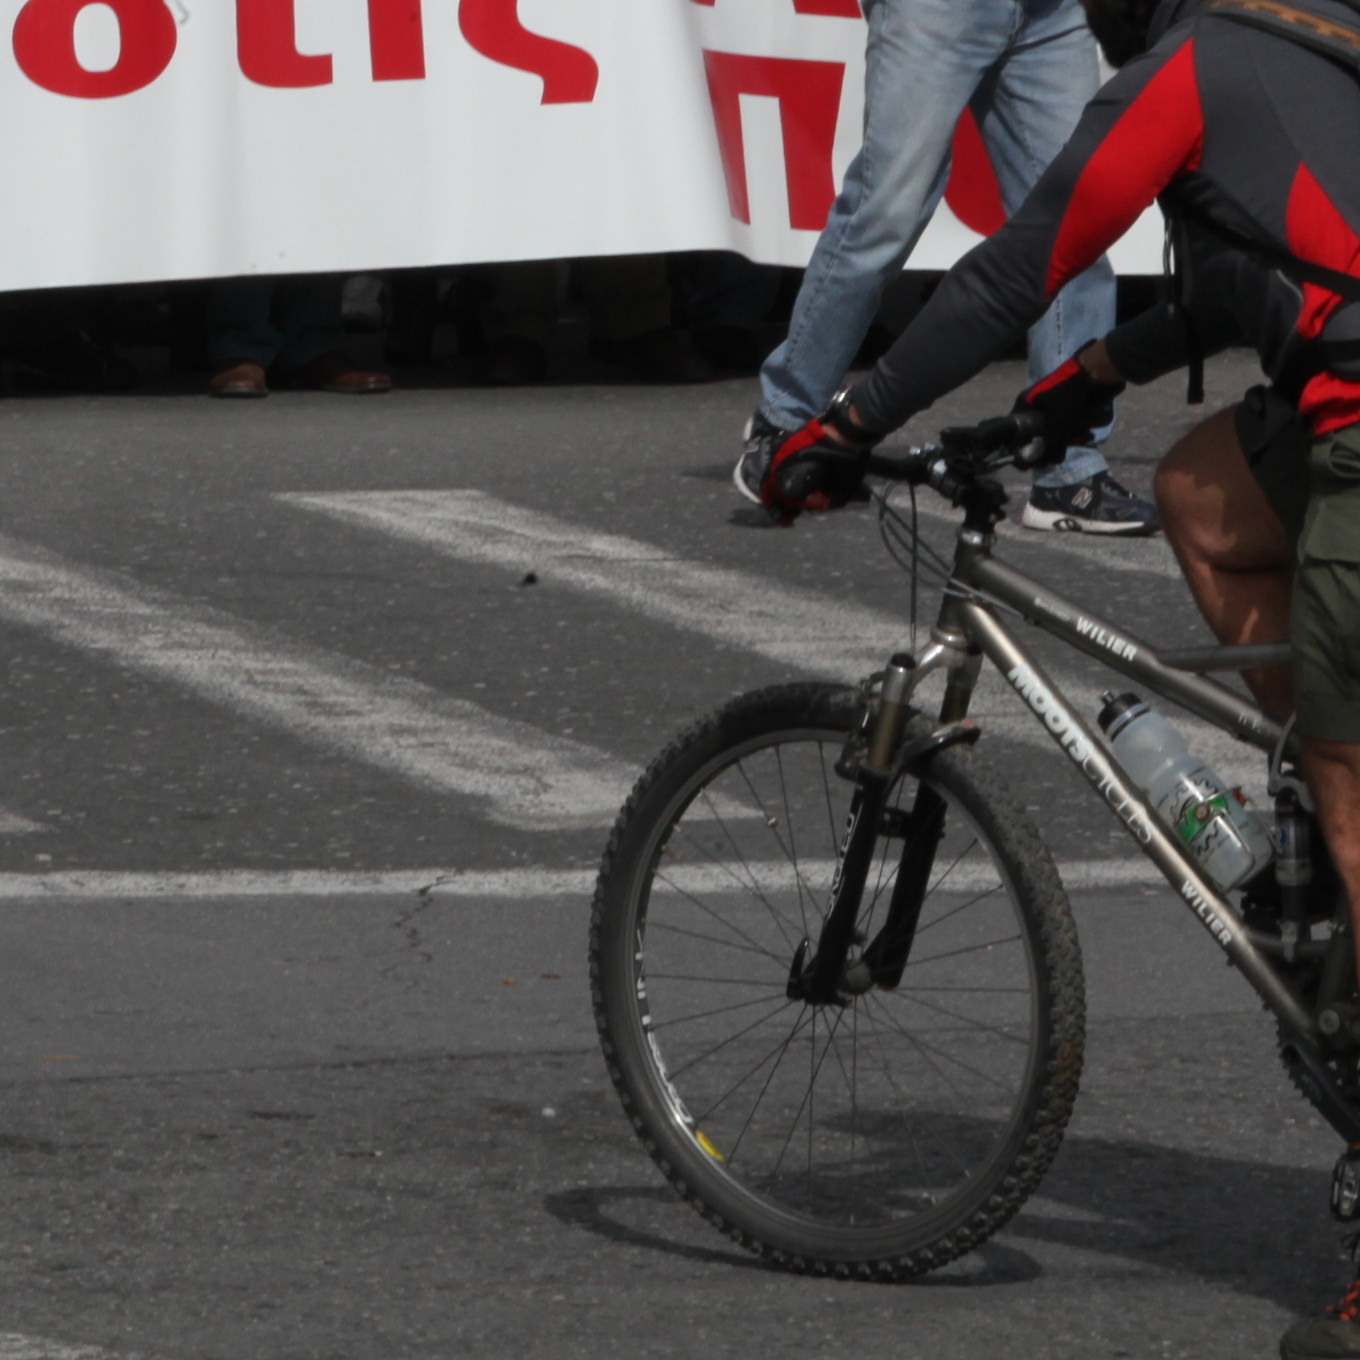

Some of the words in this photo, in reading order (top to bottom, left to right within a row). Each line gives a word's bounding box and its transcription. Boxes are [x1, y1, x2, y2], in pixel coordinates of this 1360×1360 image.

[1076, 615, 1138, 662] WILIER
[1007, 662, 1094, 762] MOOTS
[1180, 879, 1233, 947] WILIER
